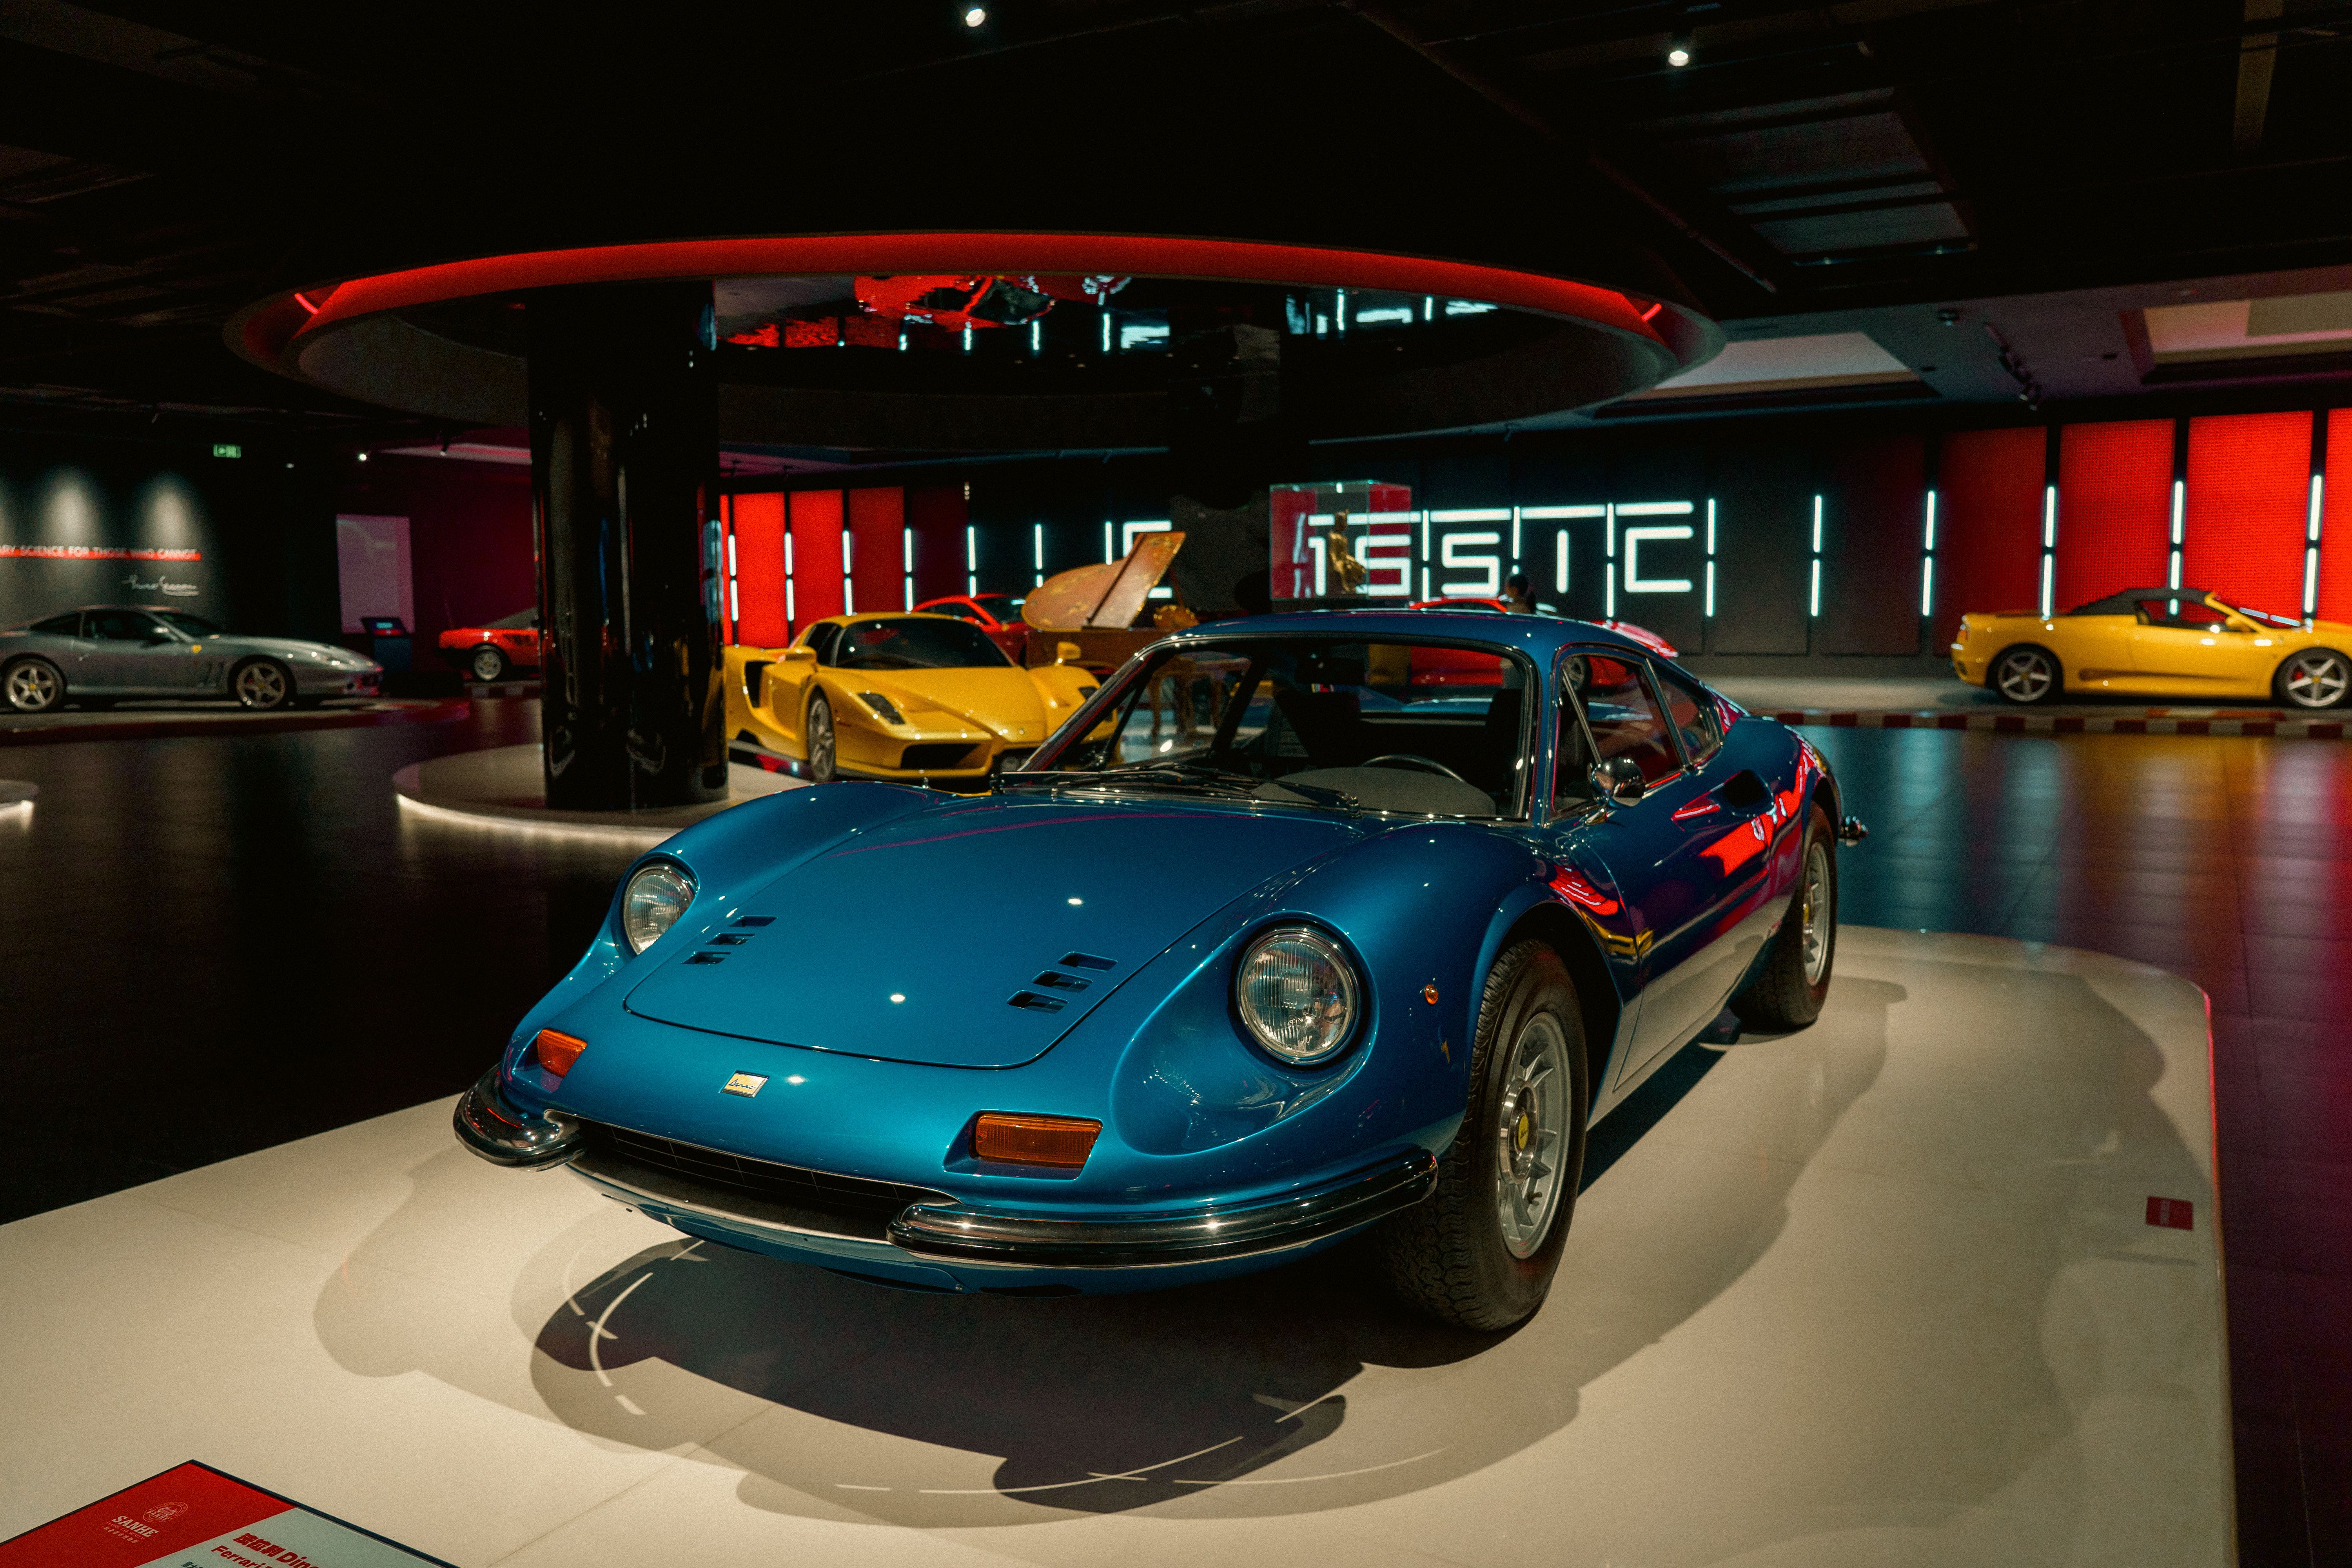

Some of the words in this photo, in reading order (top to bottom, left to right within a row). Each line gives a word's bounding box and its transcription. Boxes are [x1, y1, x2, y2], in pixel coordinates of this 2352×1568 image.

[0, 544, 16, 557] RY
[20, 545, 65, 557] SCIENCE
[68, 546, 90, 558] FOR
[157, 548, 197, 560] CANNOT
[111, 1515, 159, 1537] SANHE
[147, 1510, 170, 1521] SANHE
[232, 1533, 286, 1557] 法拉利
[211, 1545, 266, 1568] Ferrari
